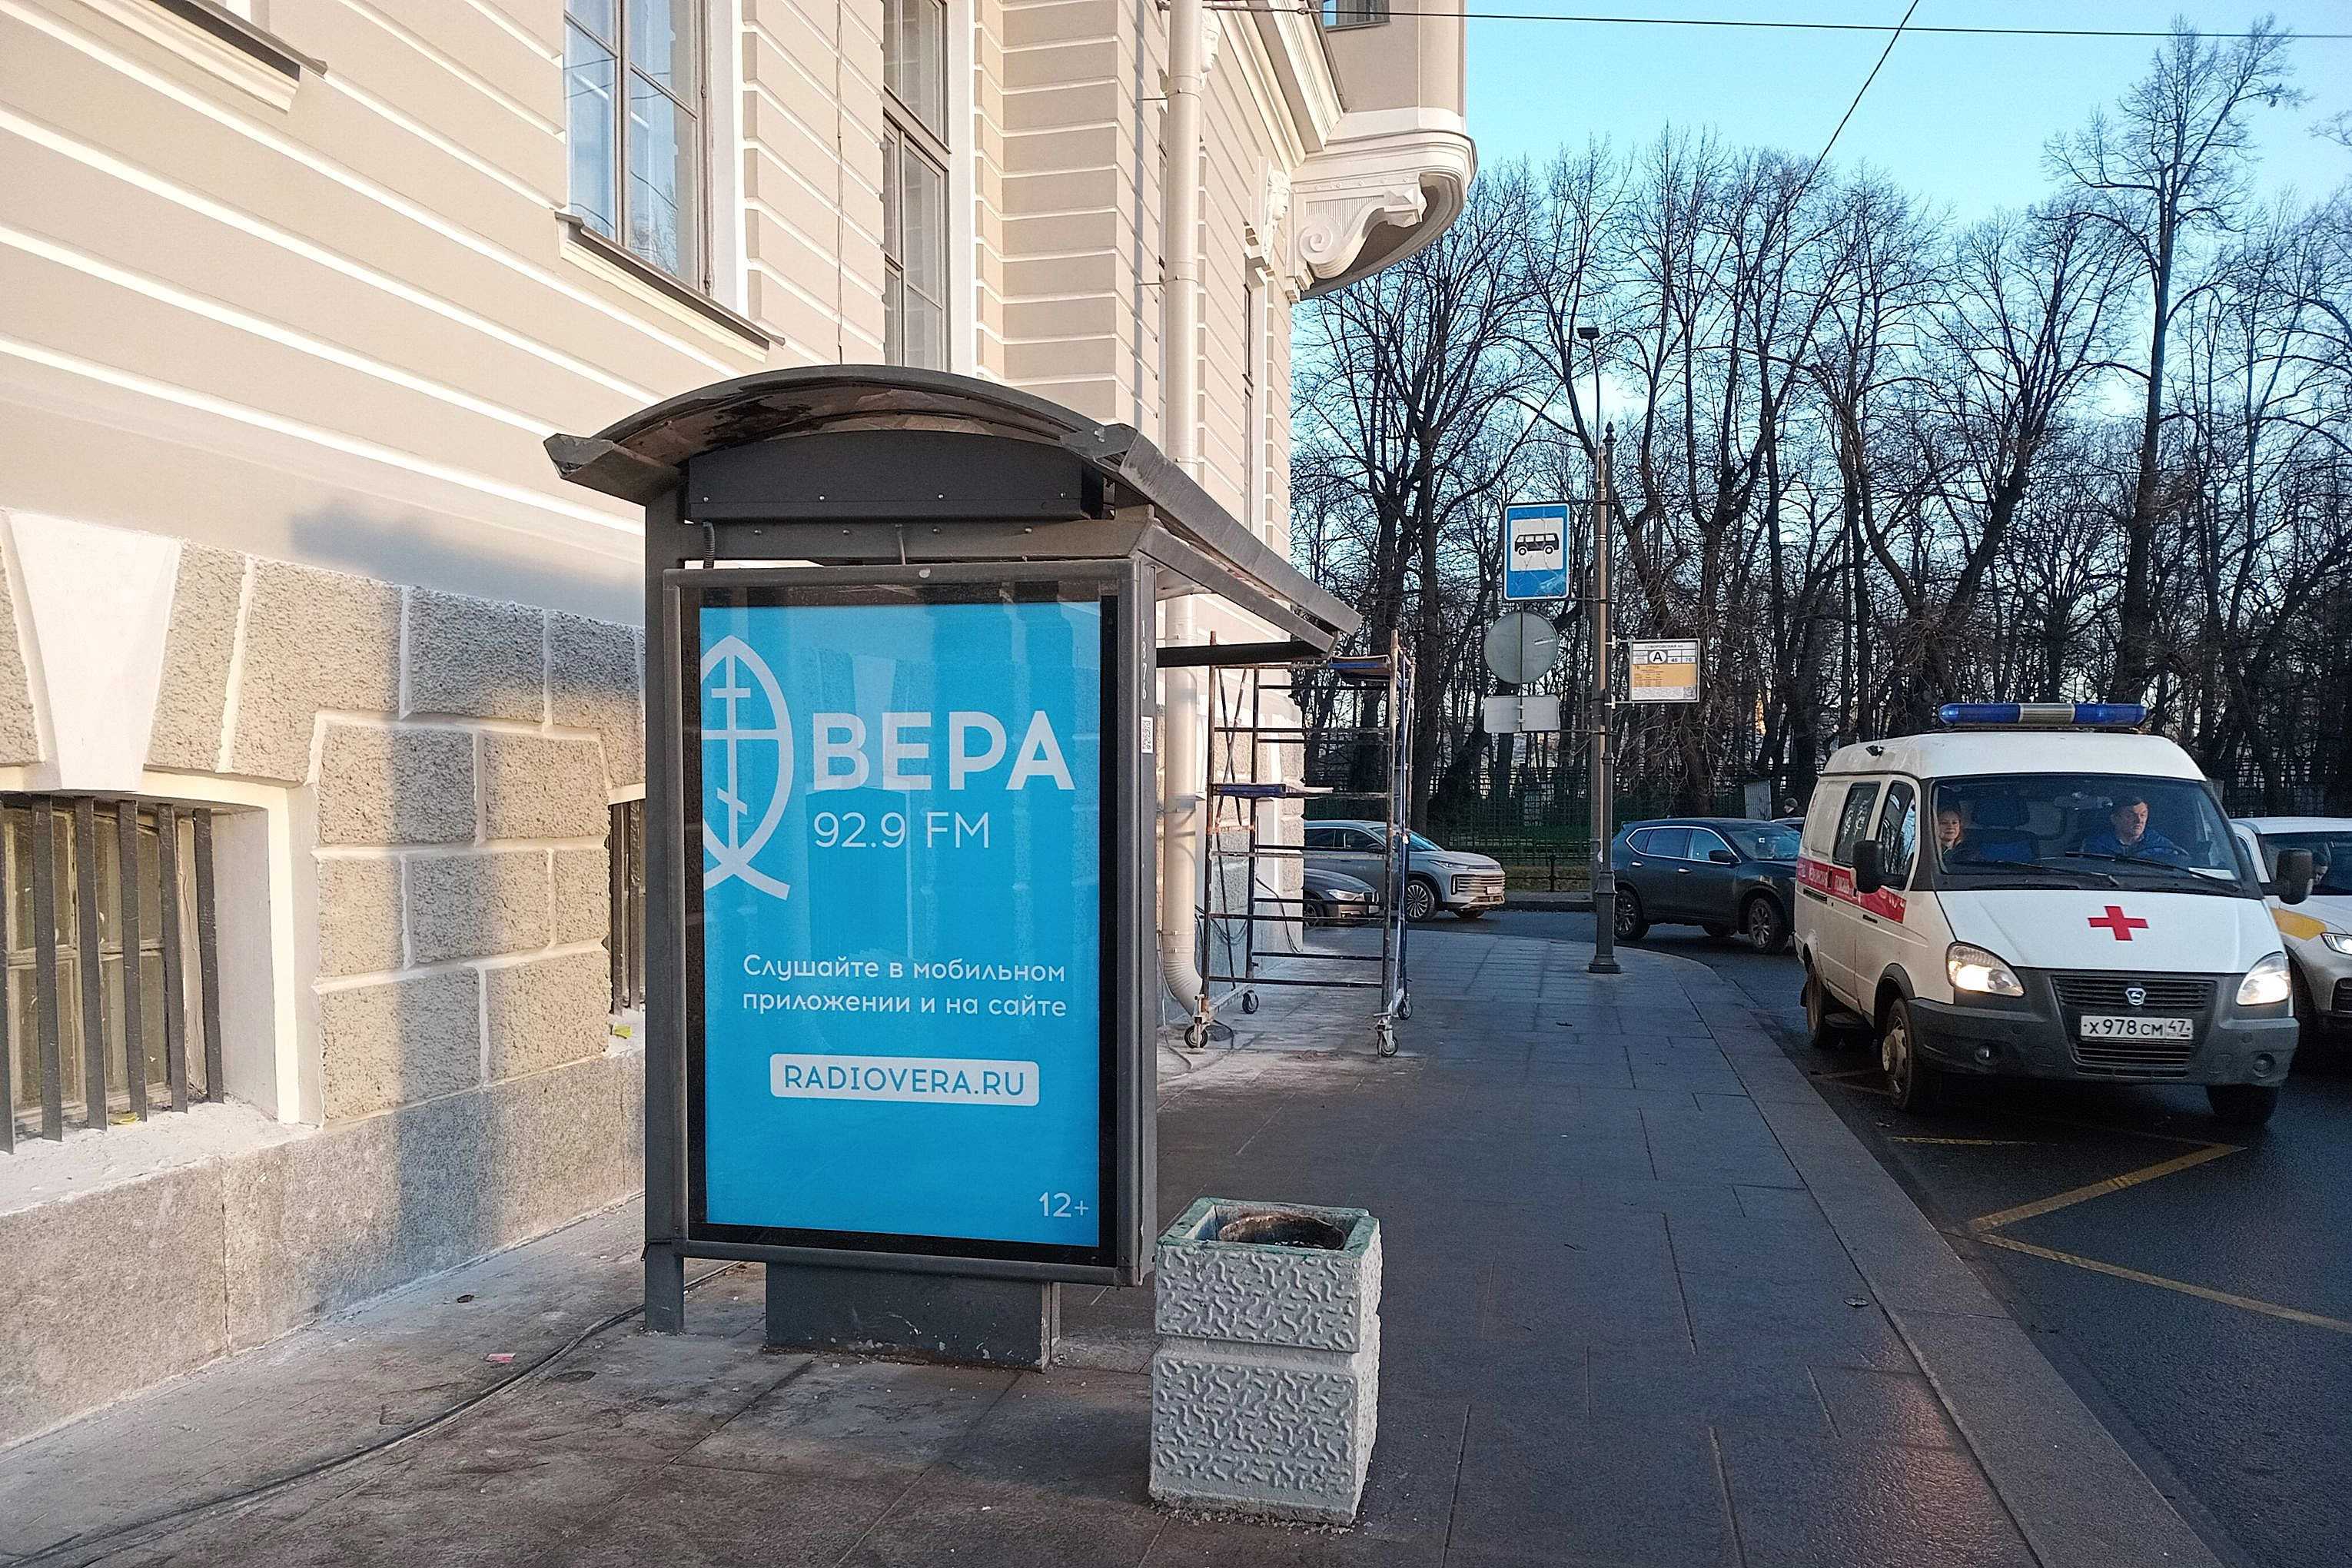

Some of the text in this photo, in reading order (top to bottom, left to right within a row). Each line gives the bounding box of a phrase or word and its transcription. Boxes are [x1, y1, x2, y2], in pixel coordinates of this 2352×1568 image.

[812, 710, 1075, 791] ВЕРА
[814, 812, 990, 849] 92.9 FM
[743, 954, 1065, 982] Слушайте в мобильном
[743, 993, 1067, 1017] приложении и на сайте
[783, 1064, 1025, 1097] RADIOVERA.RU
[1038, 1191, 1089, 1218] 12+
